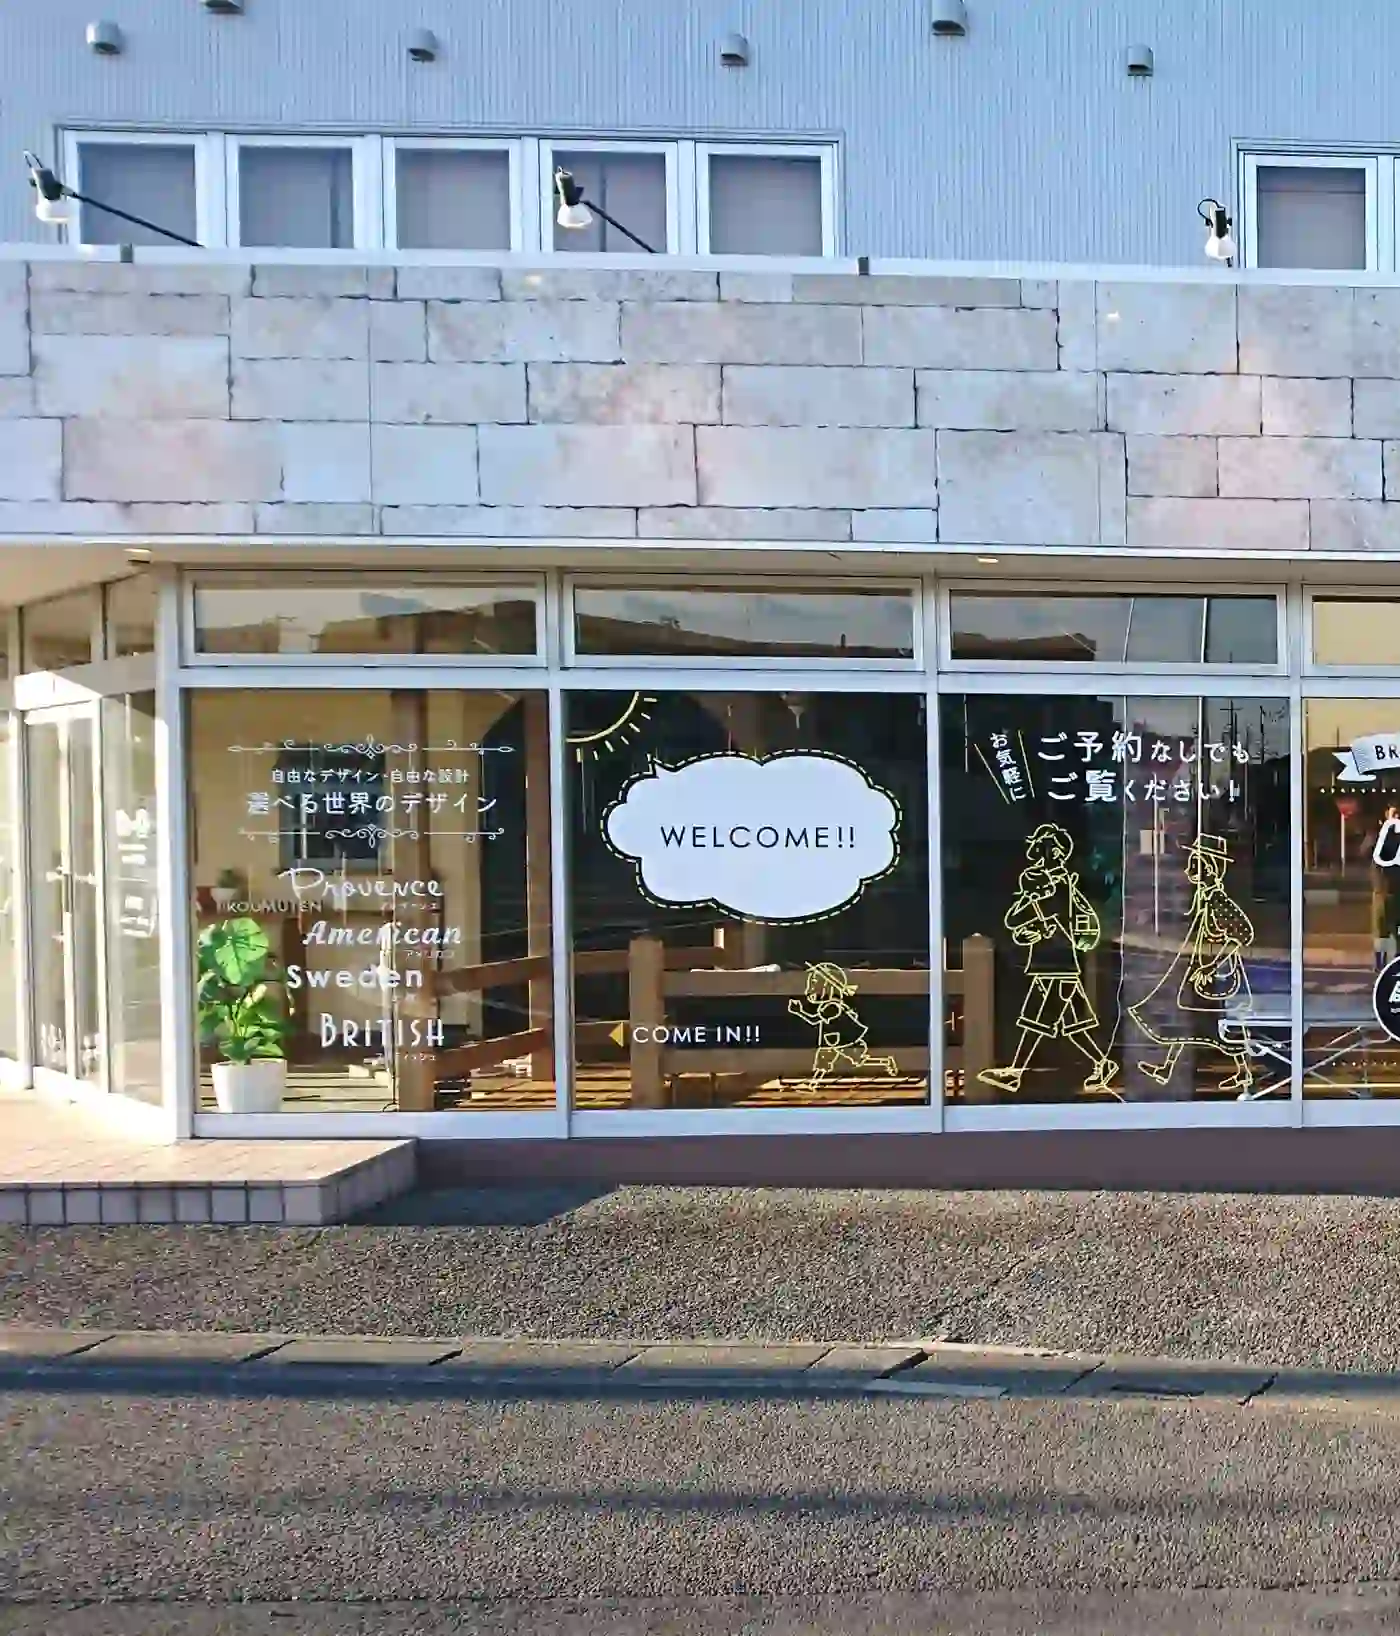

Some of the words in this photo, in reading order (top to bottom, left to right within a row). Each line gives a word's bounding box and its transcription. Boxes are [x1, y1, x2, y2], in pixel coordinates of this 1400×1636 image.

[1037, 731, 1249, 763] ご予約なしでも
[990, 732, 1027, 801] お気軽に
[1048, 769, 1240, 803] ご覧ください!
[247, 792, 497, 815] 選べる世界のデザイン
[661, 826, 856, 849] WELCOME!!
[276, 867, 444, 900] Provence
[302, 920, 461, 945] American
[287, 965, 423, 989] Sweden
[320, 1012, 445, 1047] BRITISH
[633, 1026, 706, 1043] COME
[716, 1026, 761, 1043] IN!!
